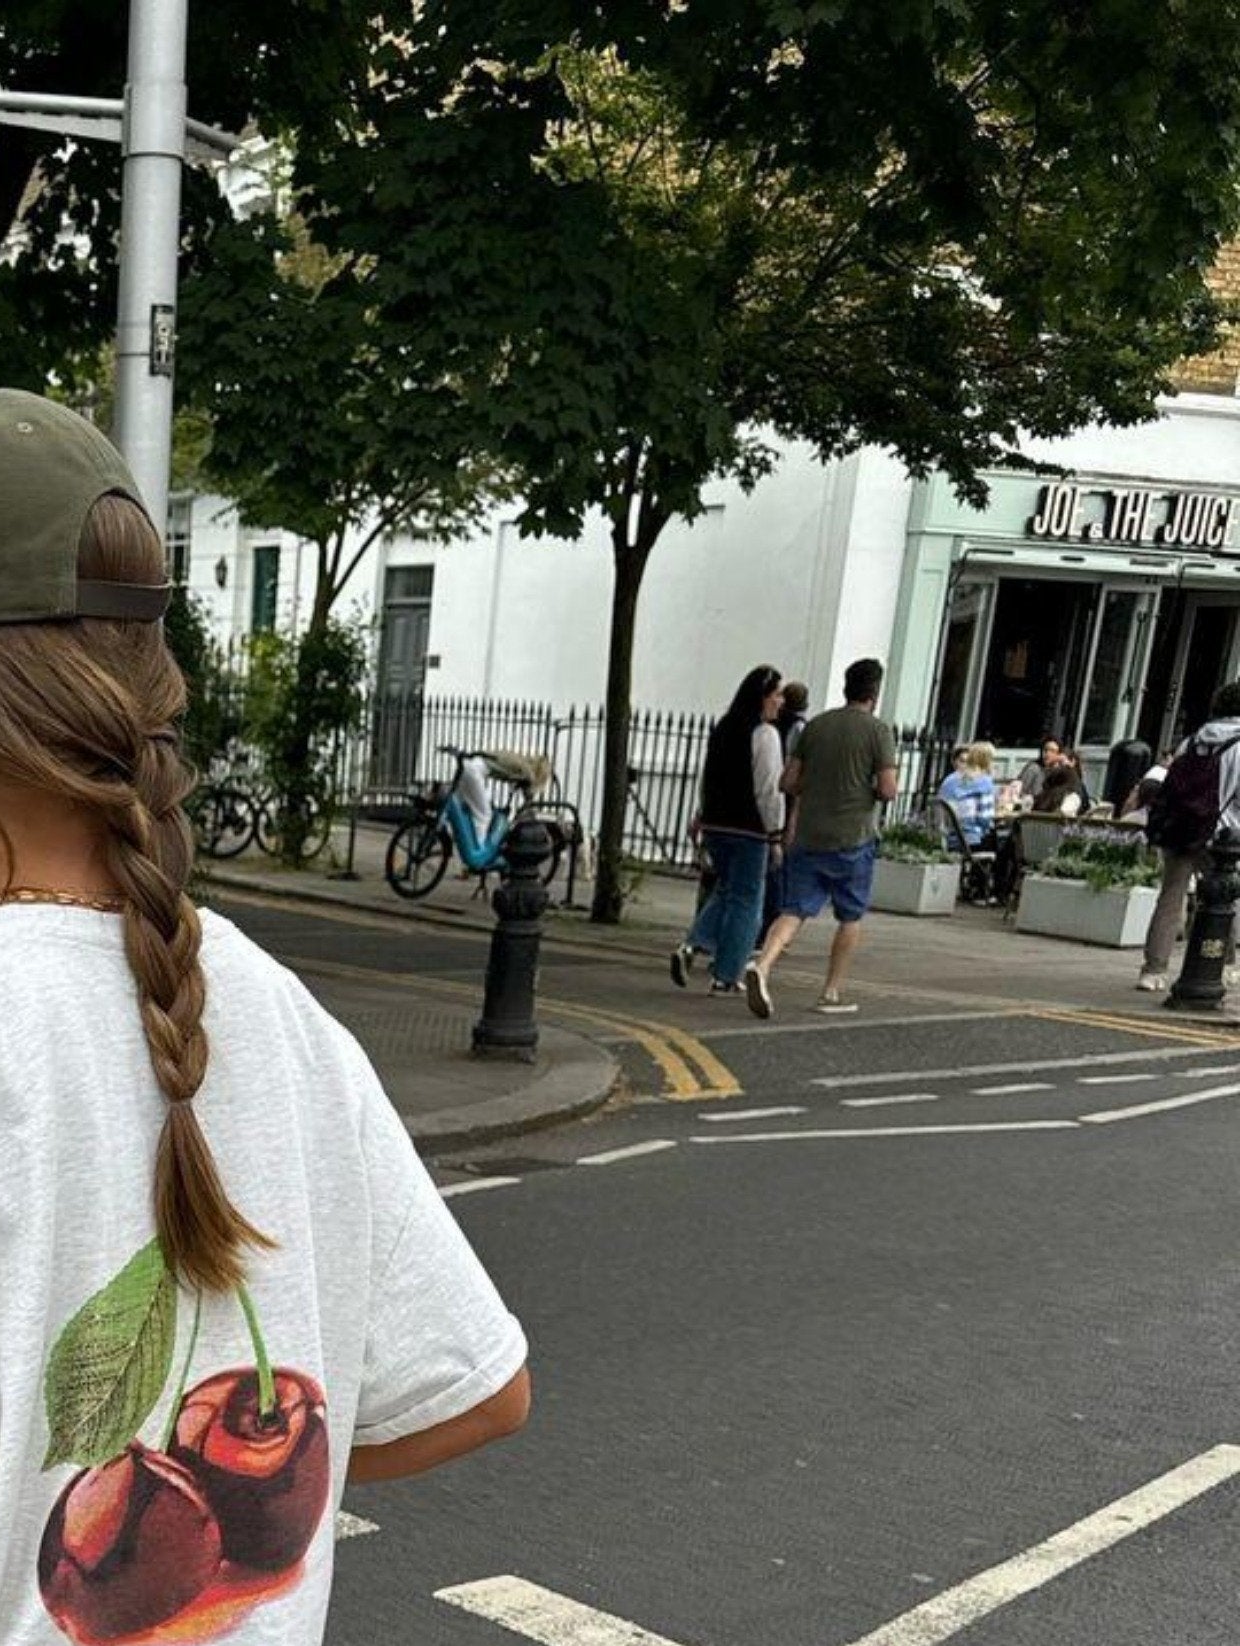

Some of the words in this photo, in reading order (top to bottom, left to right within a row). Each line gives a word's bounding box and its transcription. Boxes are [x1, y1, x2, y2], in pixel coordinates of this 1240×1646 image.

[1033, 483, 1085, 537] JOE
[1089, 523, 1103, 539] &
[1110, 490, 1160, 541] THE
[1164, 493, 1240, 546] JUICE
